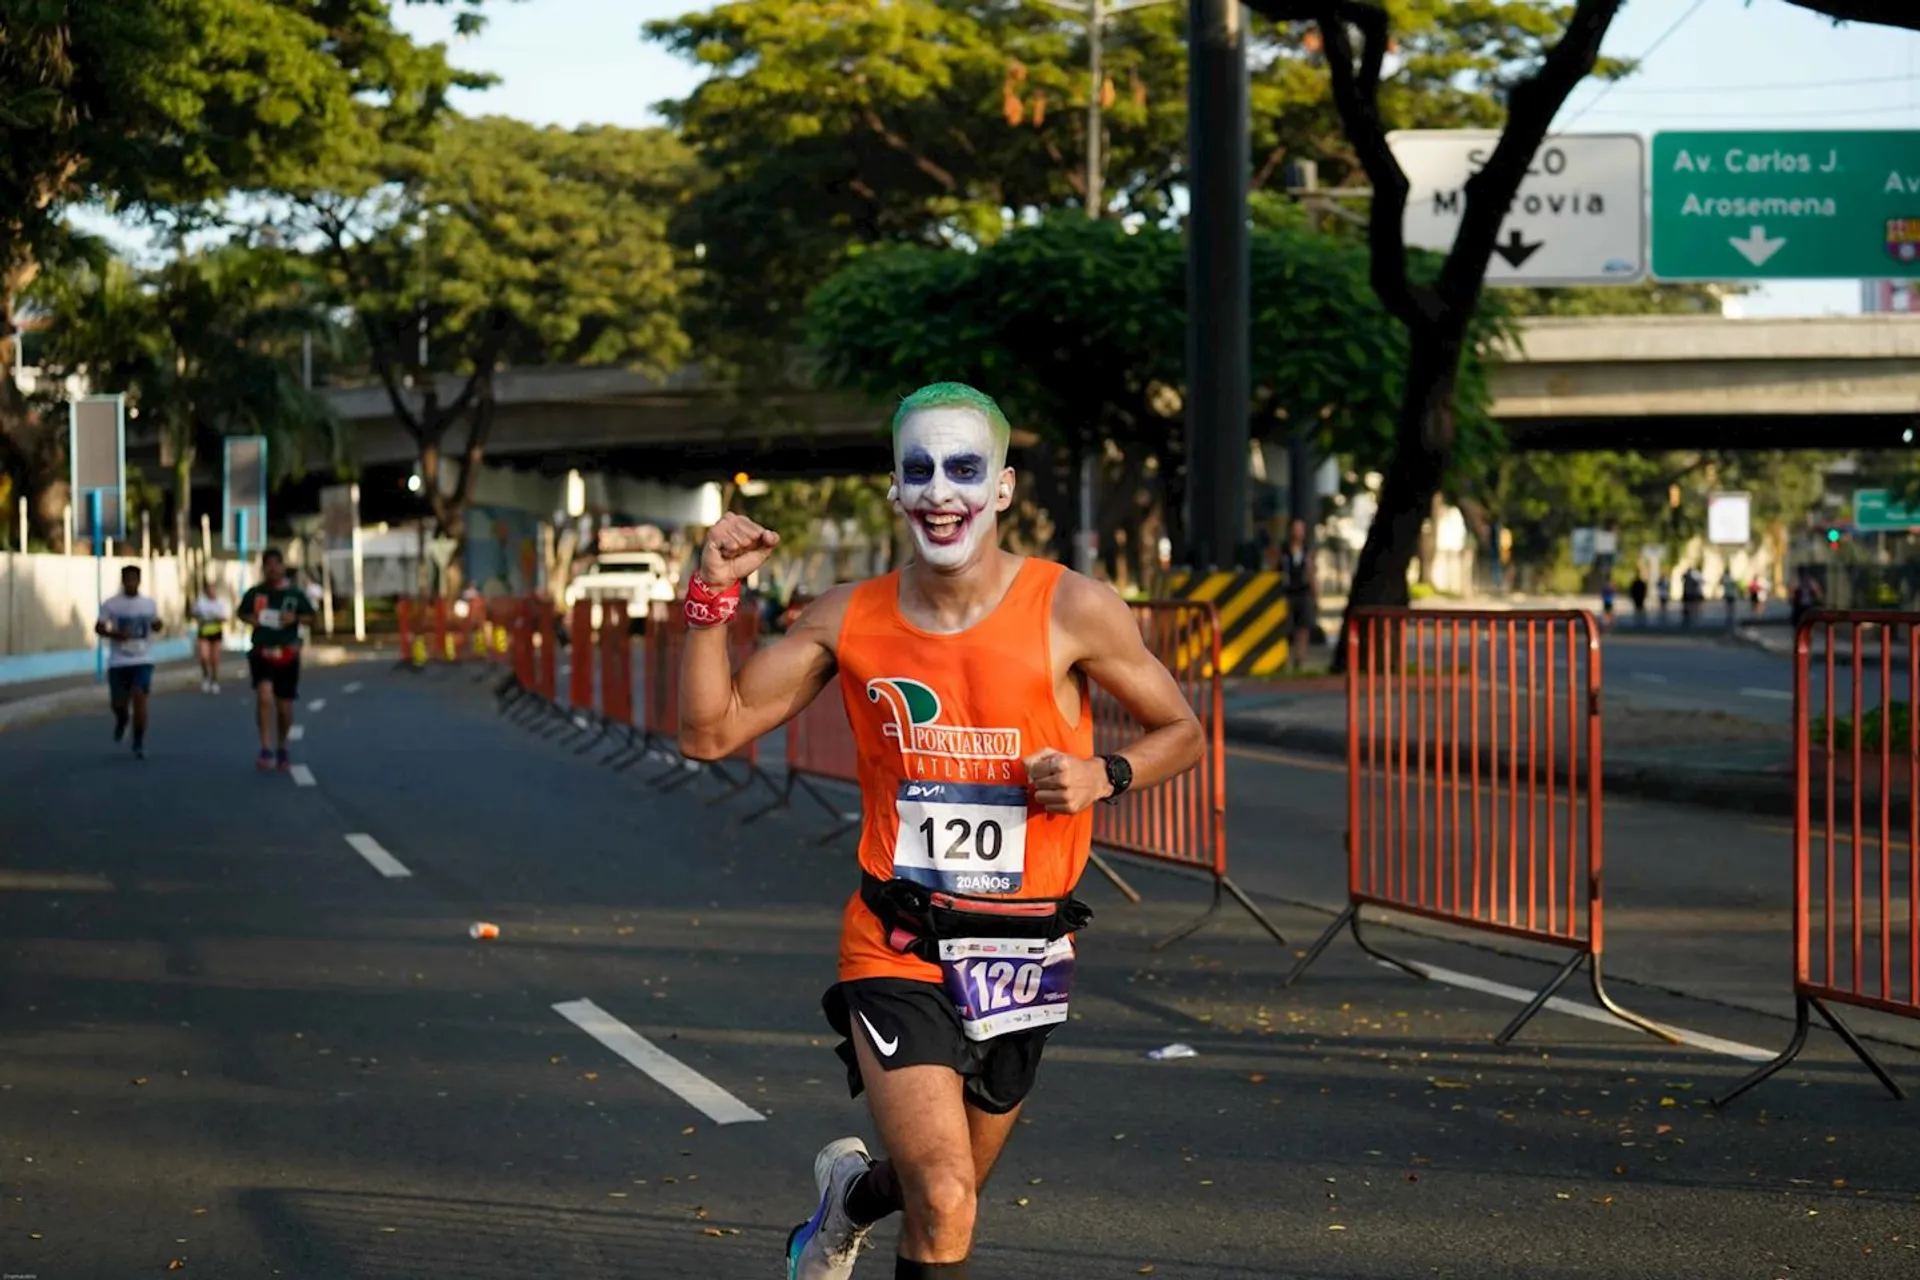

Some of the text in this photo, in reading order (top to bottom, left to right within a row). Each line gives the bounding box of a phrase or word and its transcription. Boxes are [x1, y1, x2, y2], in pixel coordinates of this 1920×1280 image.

[1724, 148, 1811, 173] Carlos
[1680, 192, 1836, 216] Arosemena
[915, 728, 1016, 755] PORTIARROZ
[917, 757, 1011, 780] ATLETAS
[919, 816, 1002, 861] 120
[970, 961, 1043, 1013] 120
